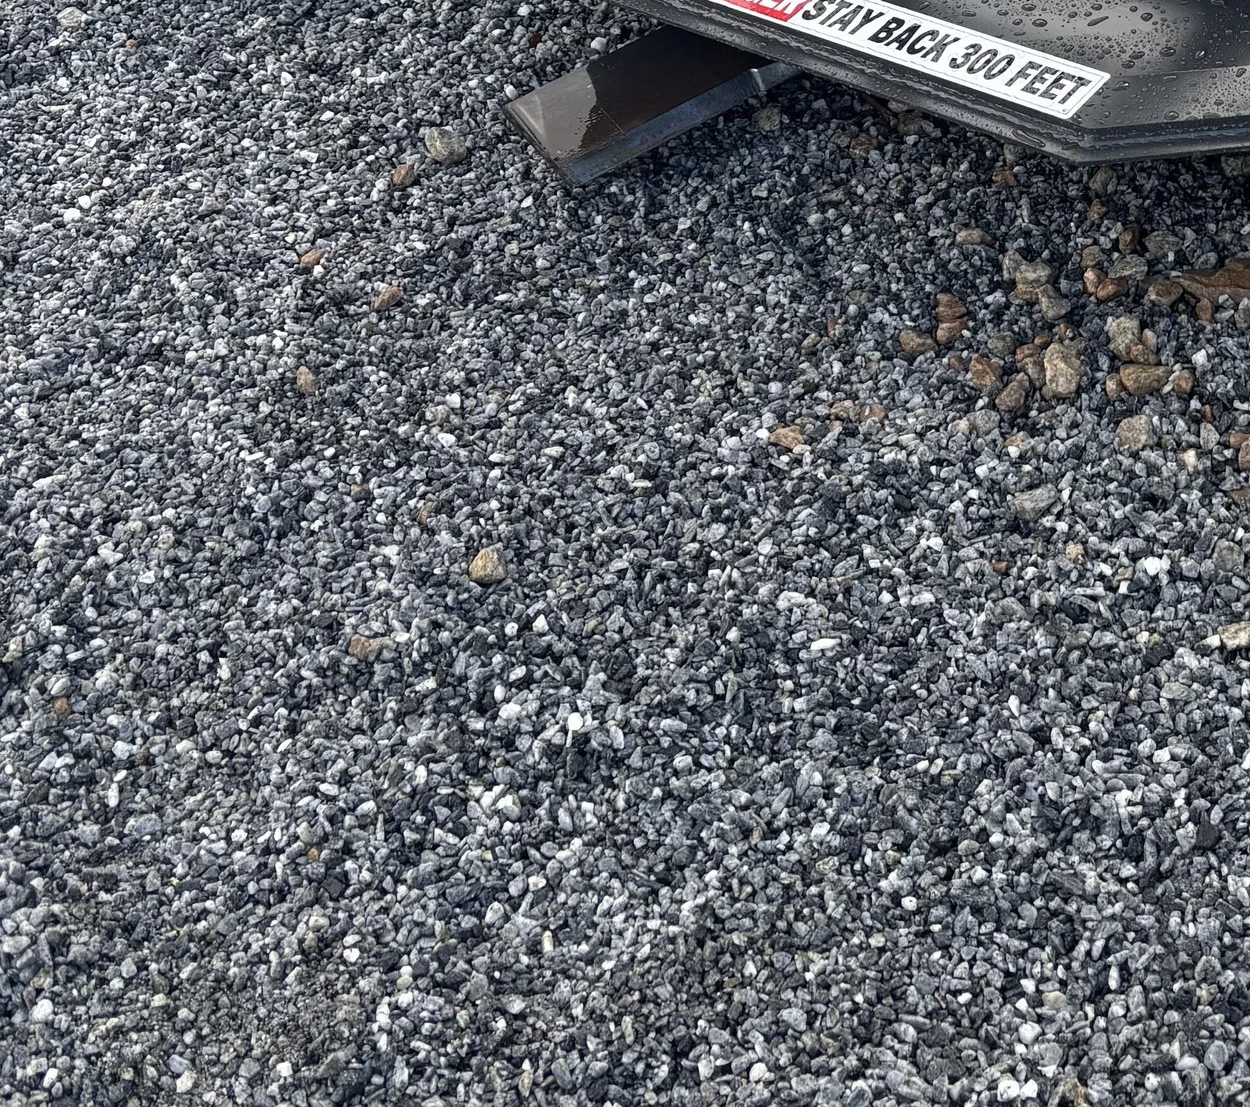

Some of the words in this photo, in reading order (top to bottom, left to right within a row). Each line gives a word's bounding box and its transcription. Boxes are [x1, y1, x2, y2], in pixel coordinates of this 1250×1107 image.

[869, 18, 952, 64] BACK
[949, 42, 1014, 82] 300
[1004, 60, 1091, 105] FEET
